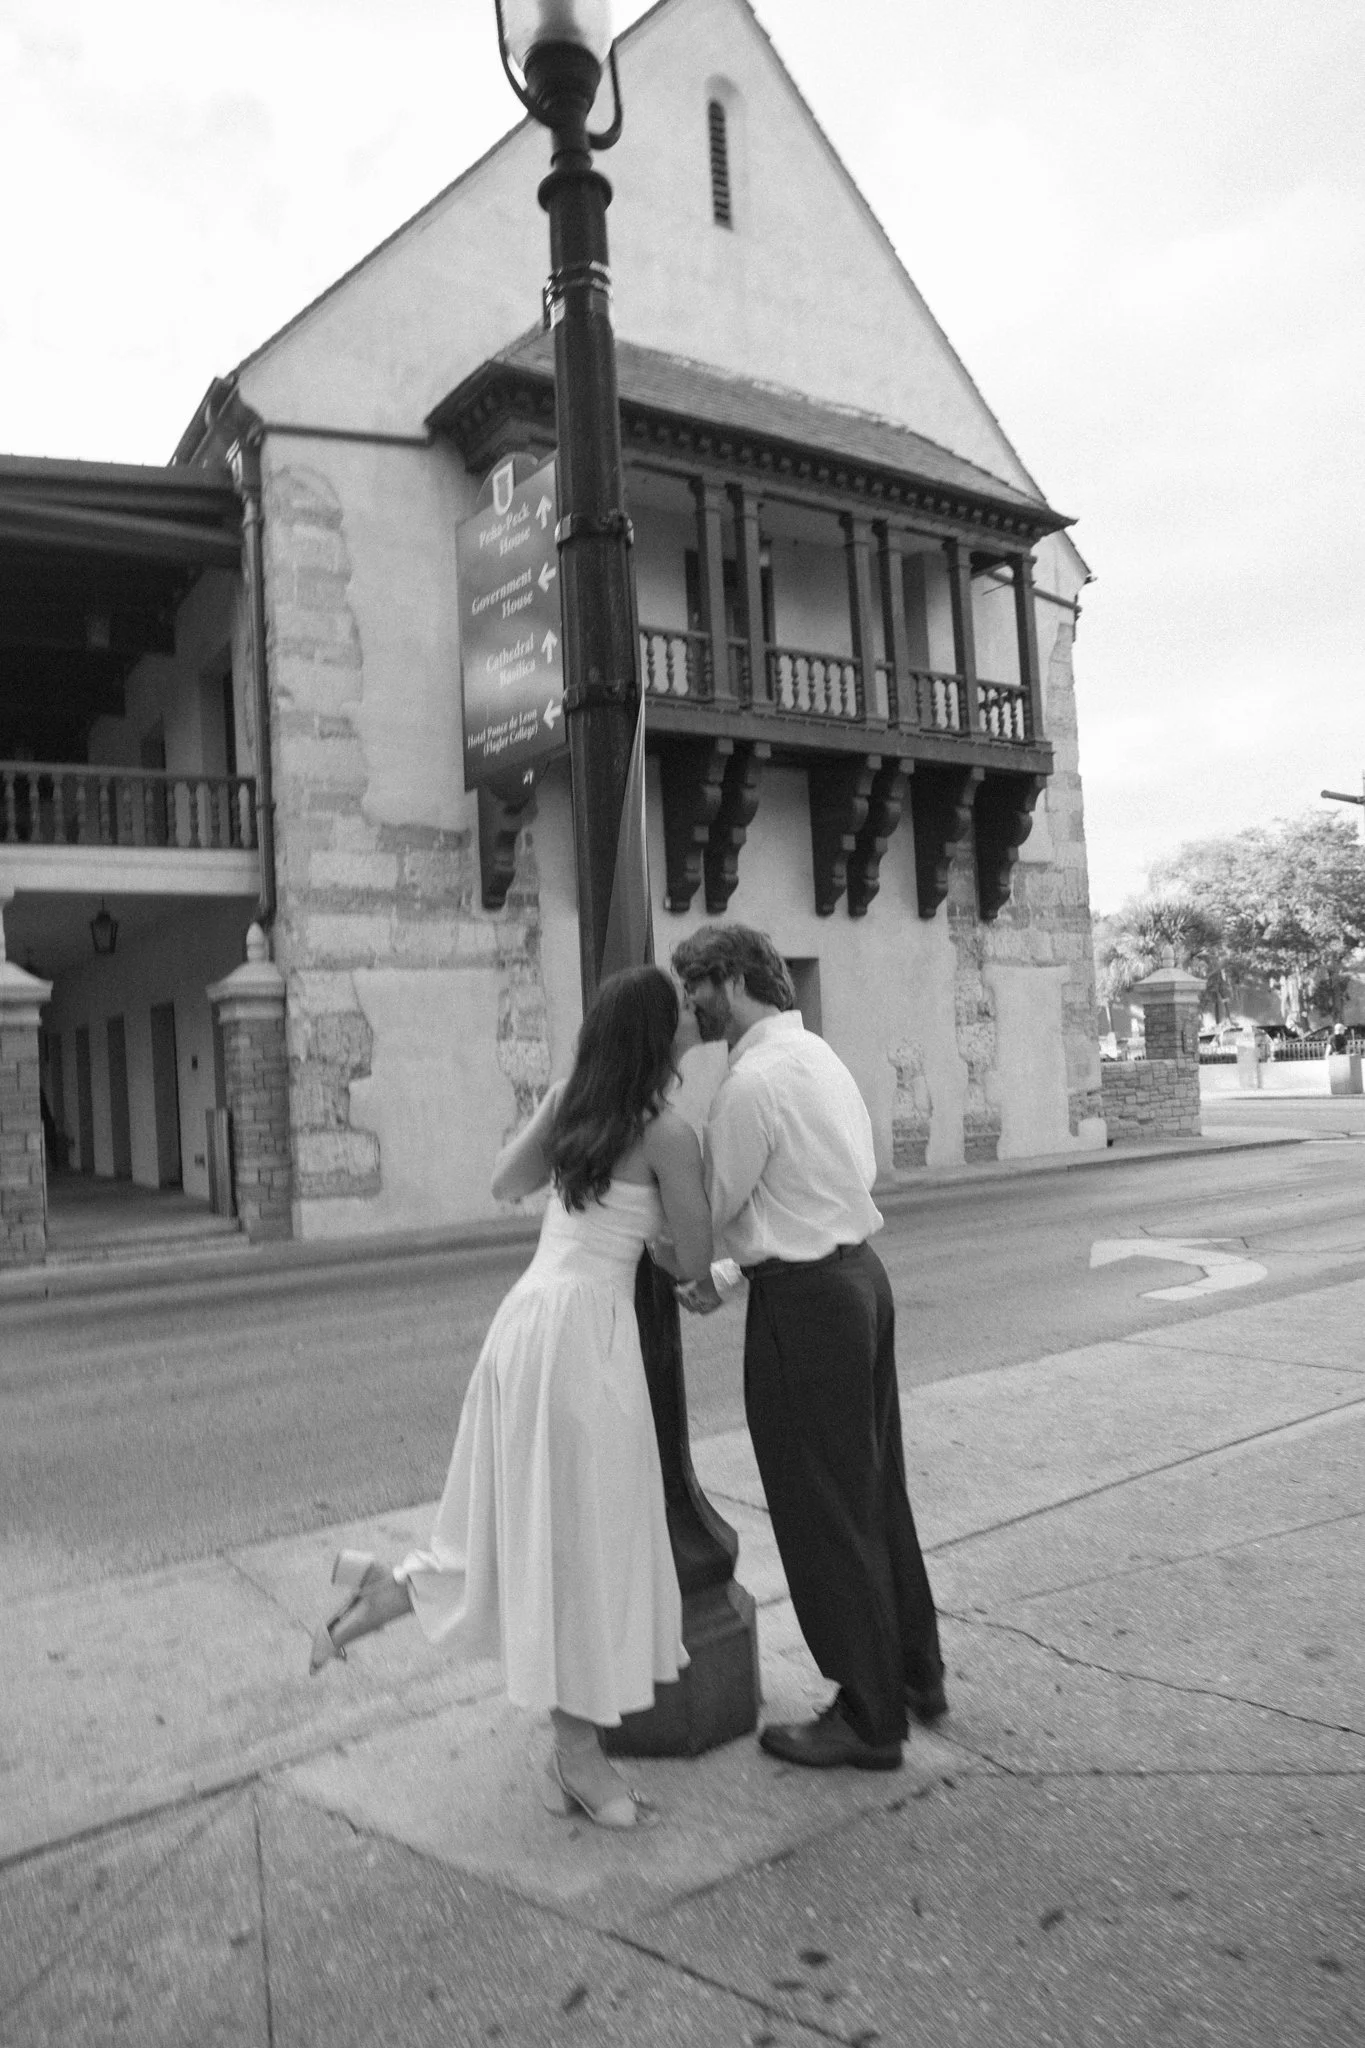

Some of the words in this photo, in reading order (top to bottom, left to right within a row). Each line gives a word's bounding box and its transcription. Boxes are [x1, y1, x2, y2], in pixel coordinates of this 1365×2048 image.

[499, 526, 531, 557] House
[471, 567, 532, 616] Government
[502, 590, 534, 619] House
[486, 632, 534, 674] Cathedral
[499, 658, 536, 688] Basilica
[467, 728, 486, 750] Hotel
[487, 721, 508, 740] Ponce
[509, 715, 518, 730] de
[509, 720, 539, 745] College)
